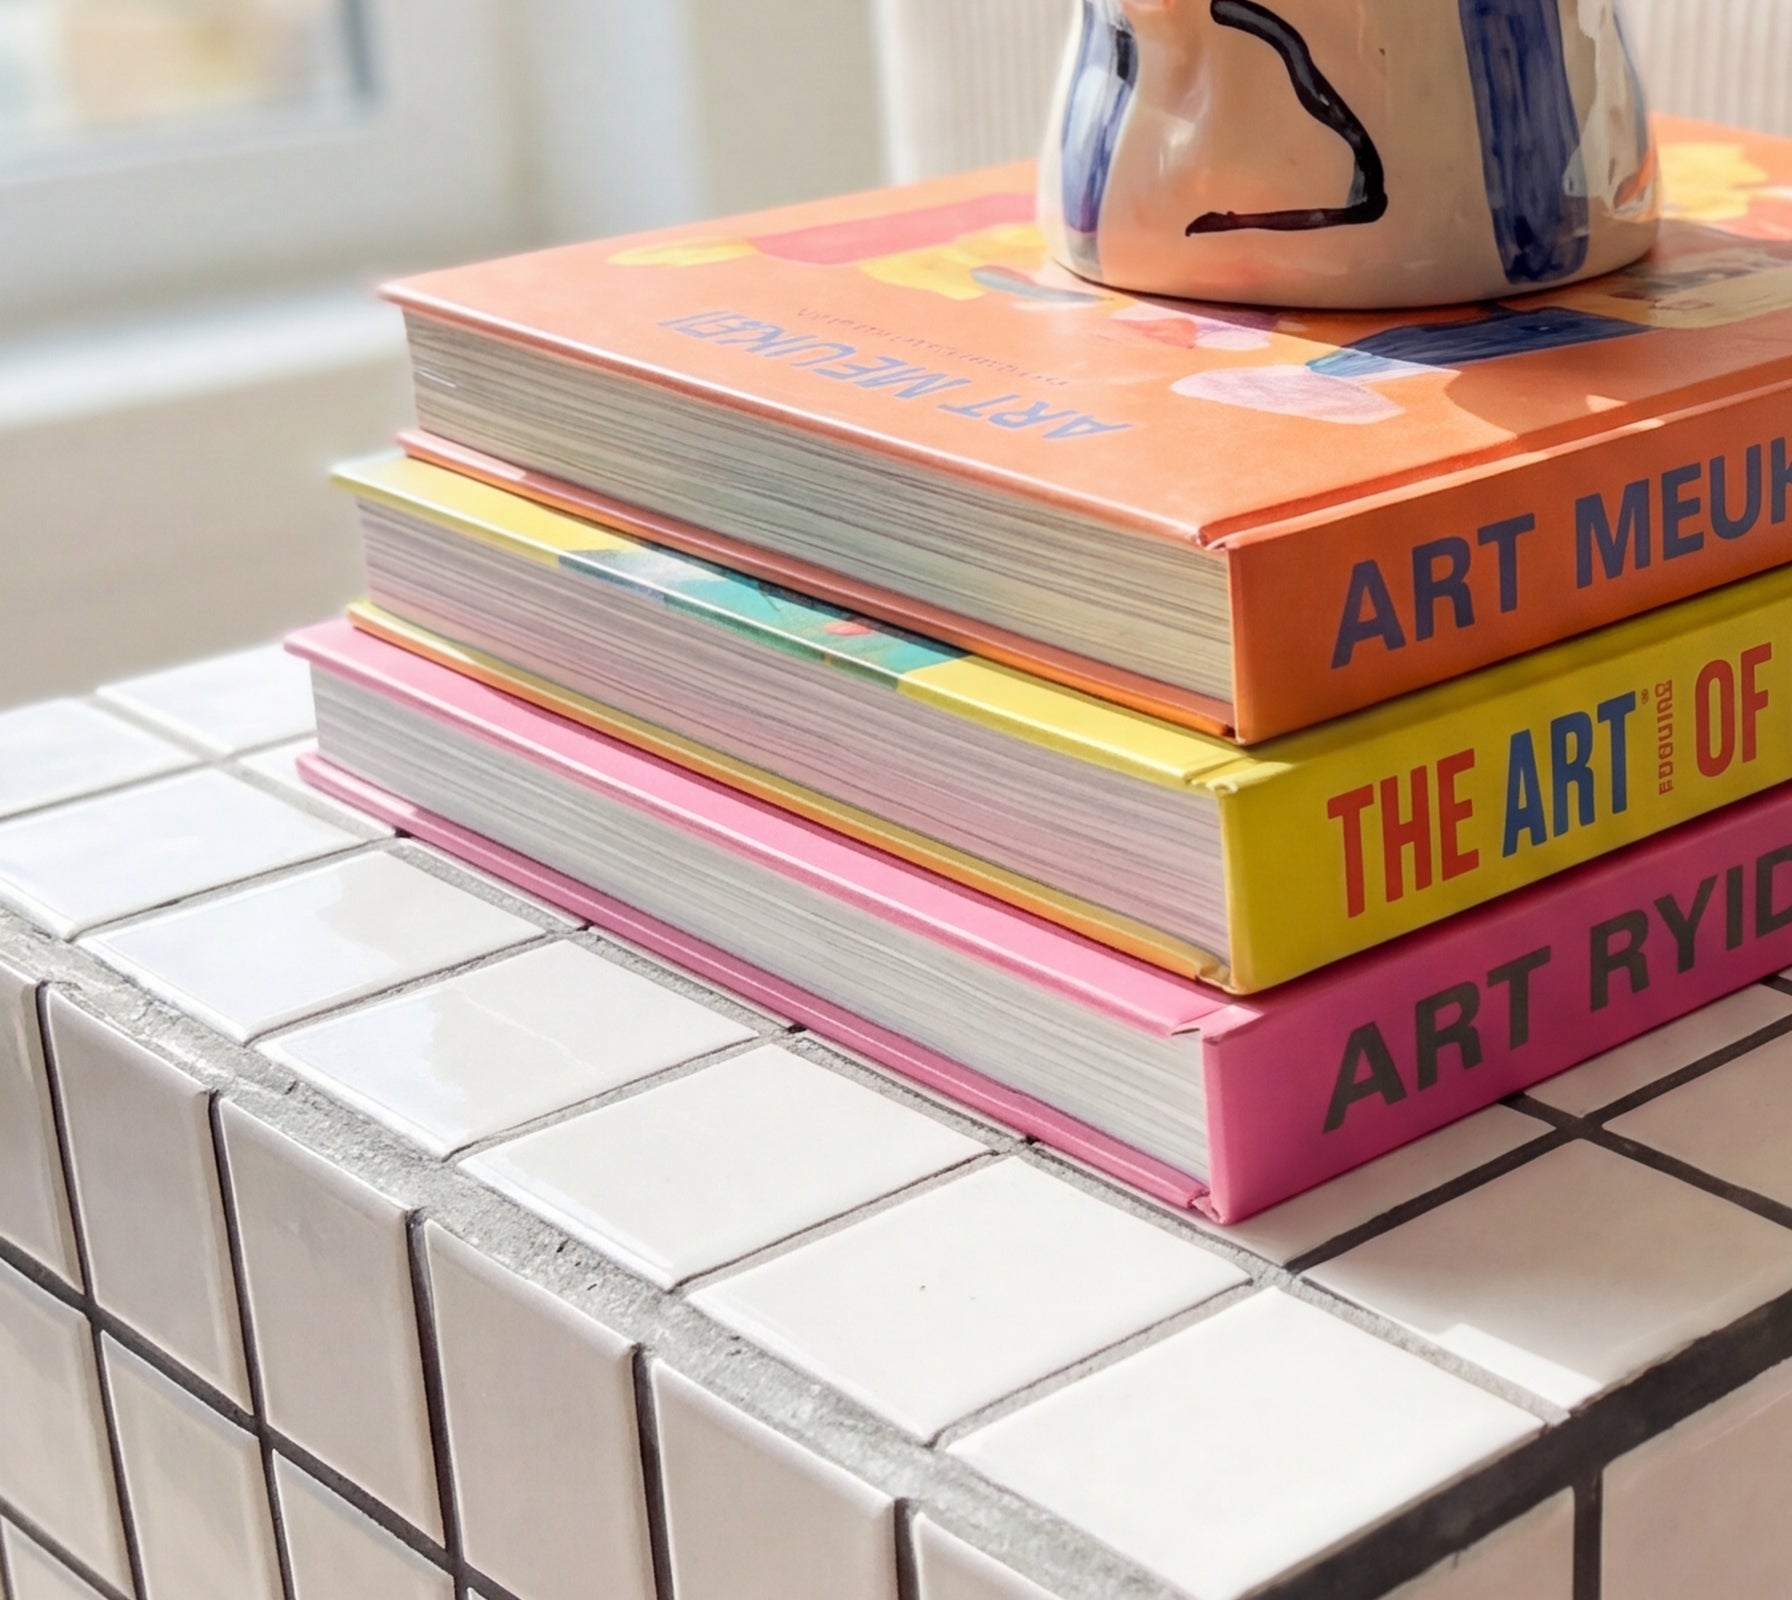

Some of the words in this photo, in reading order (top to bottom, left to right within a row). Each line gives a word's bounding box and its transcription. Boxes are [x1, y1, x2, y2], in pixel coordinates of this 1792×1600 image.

[938, 394, 1134, 440] ART
[1331, 512, 1535, 670] ART
[1327, 747, 1480, 919] THE
[1502, 690, 1637, 859] ART
[1695, 642, 1773, 778] OF
[1323, 945, 1552, 1134] ART
